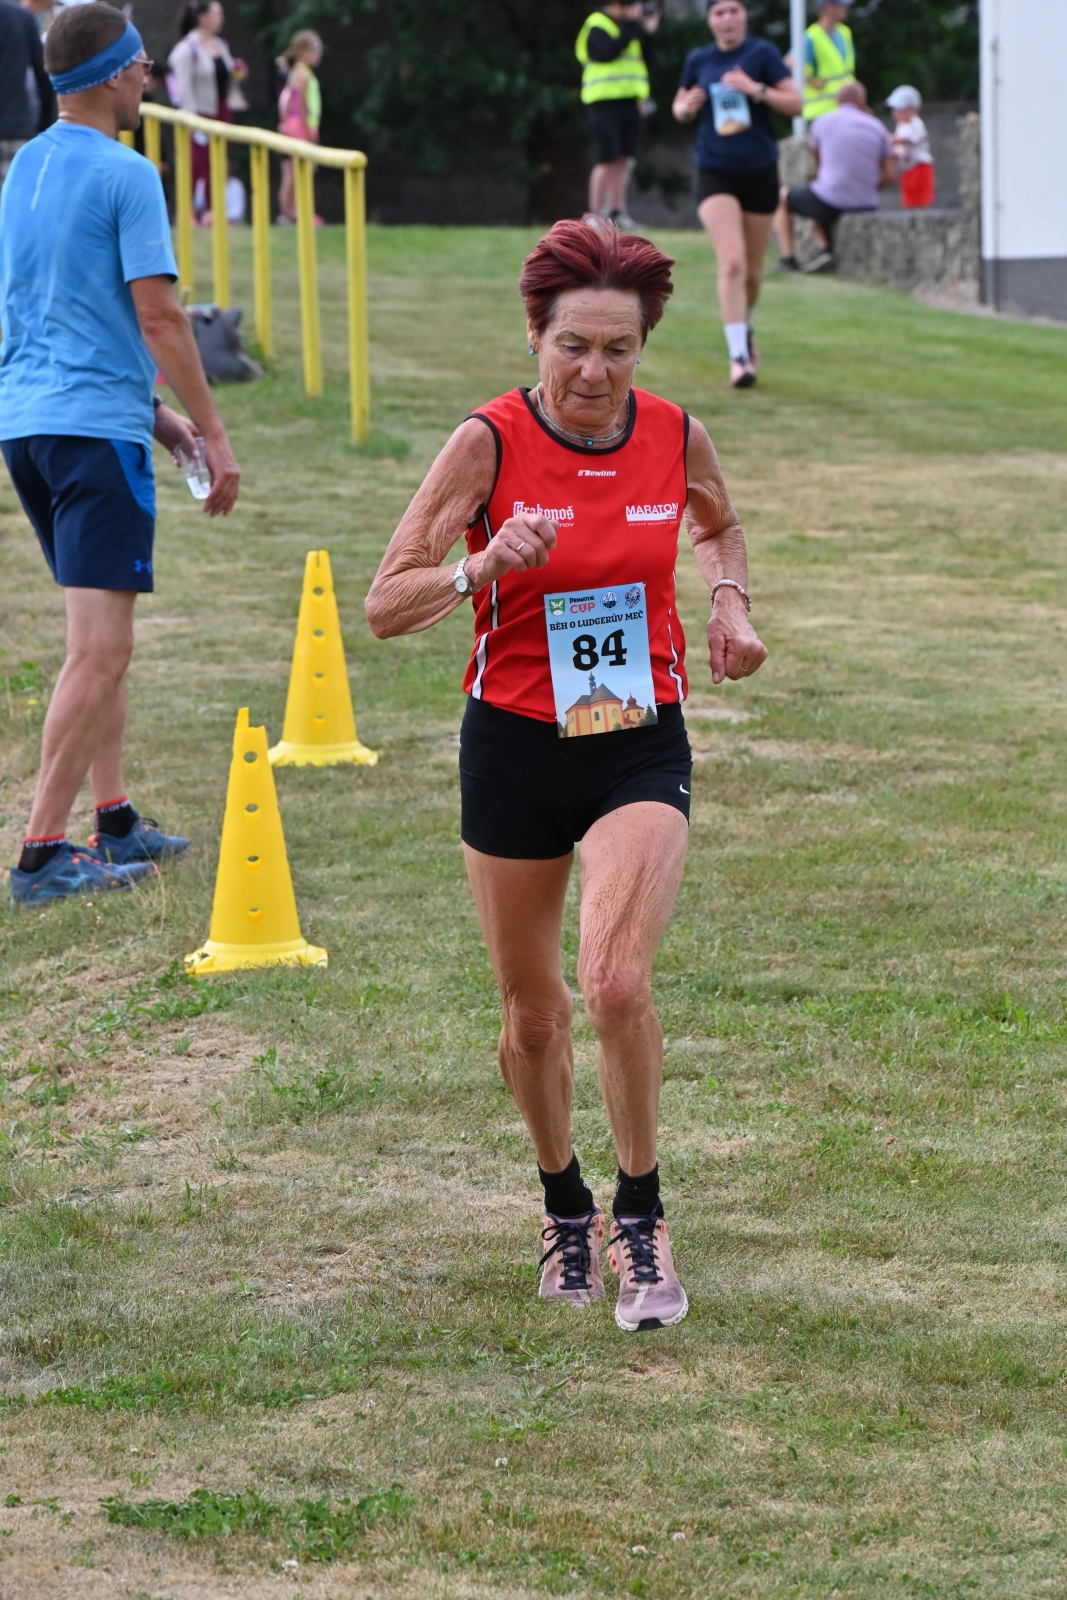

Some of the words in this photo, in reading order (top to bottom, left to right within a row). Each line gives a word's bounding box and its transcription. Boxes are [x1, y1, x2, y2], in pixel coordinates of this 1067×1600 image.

[625, 502, 679, 515] MARATON
[569, 602, 596, 614] CUP
[549, 621, 568, 631] BĚH
[569, 621, 577, 629] O
[577, 613, 624, 628] LUDGERŮV
[625, 609, 644, 621] MEČ
[572, 628, 628, 671] 84
